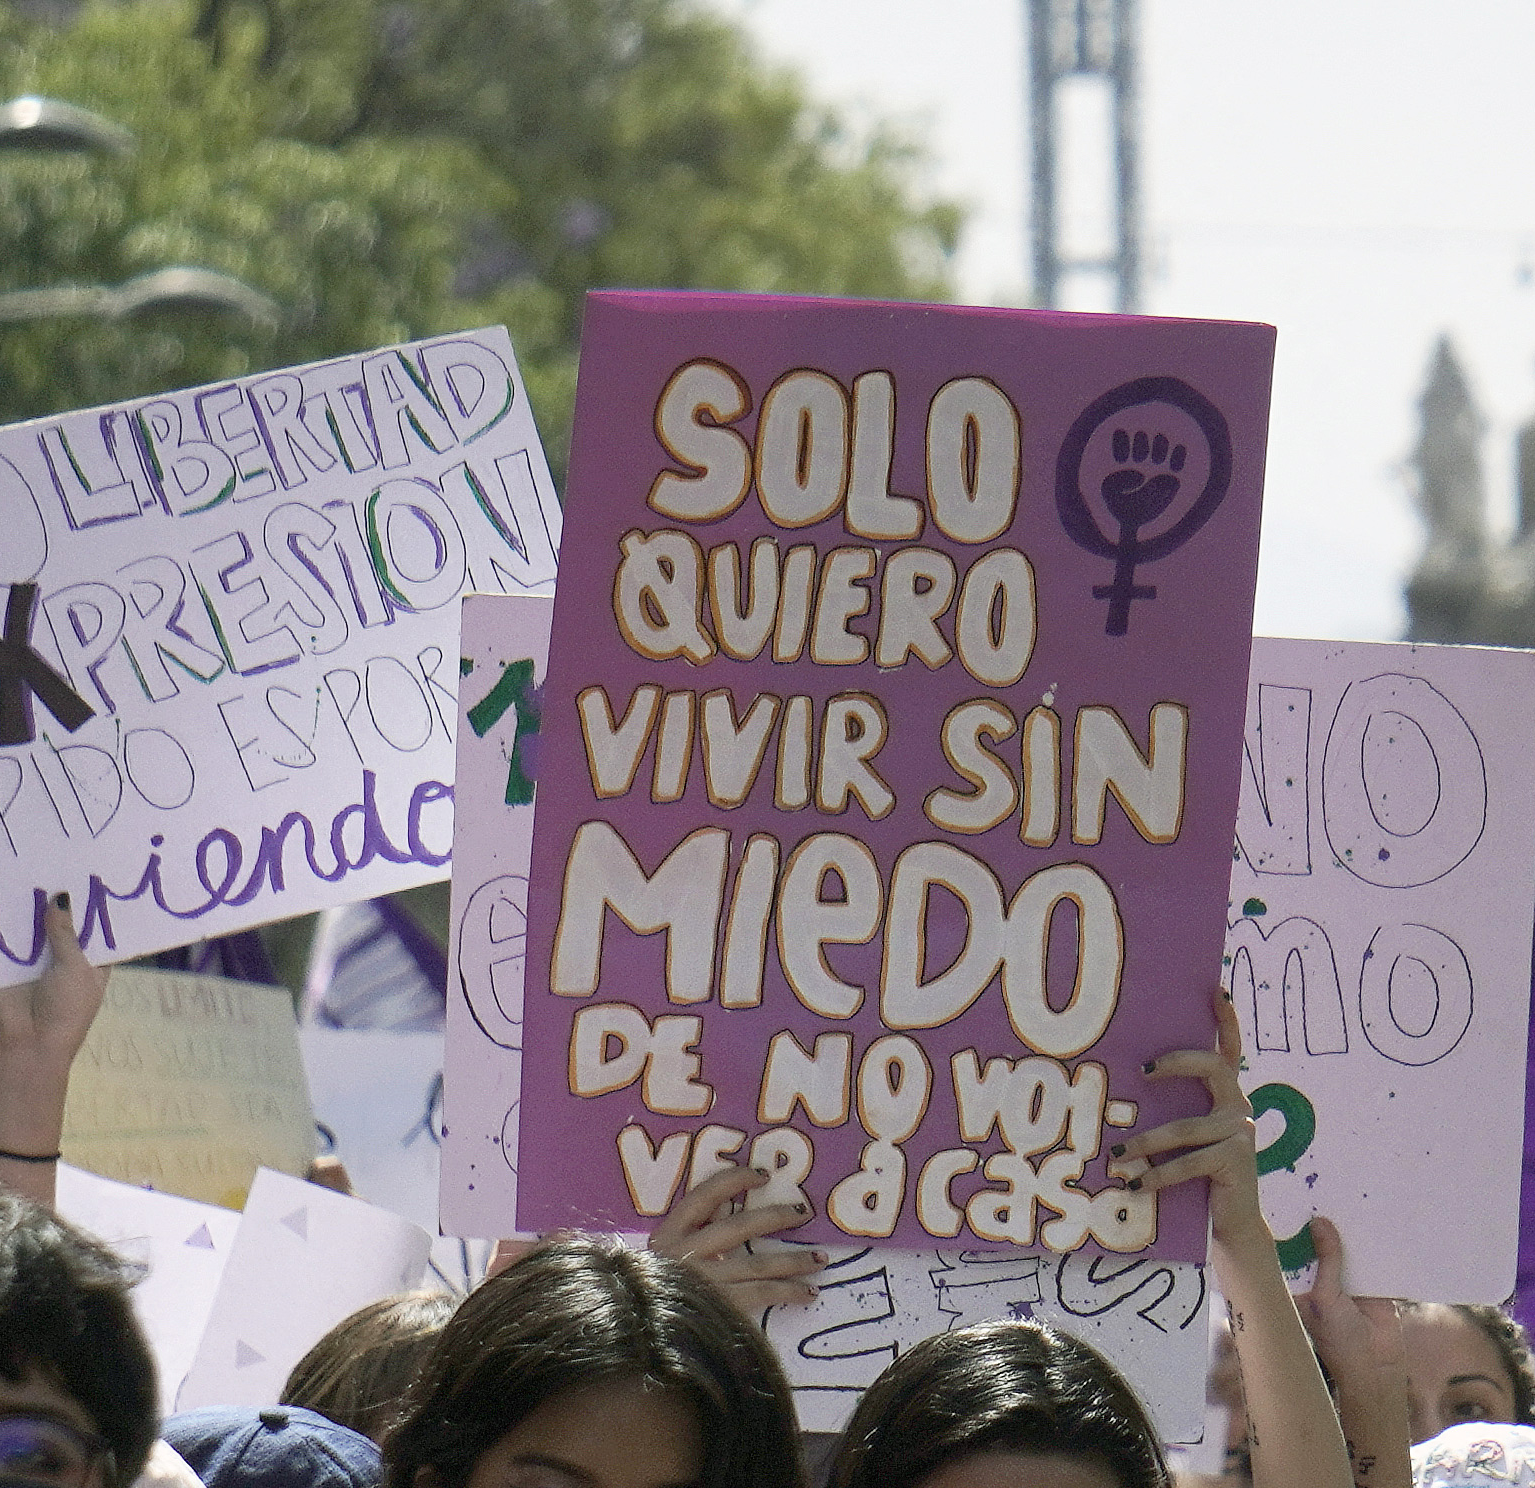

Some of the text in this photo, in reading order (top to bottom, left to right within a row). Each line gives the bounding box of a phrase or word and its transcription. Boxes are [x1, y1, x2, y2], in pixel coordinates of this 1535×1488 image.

[37, 340, 515, 530] LIBERTAD
[649, 356, 1022, 544] SOLO
[613, 528, 1039, 688] QUIERO
[576, 685, 1188, 847] VIVIR SIN
[567, 1003, 715, 1117] DE
[757, 1028, 933, 1148] NO
[826, 1138, 908, 1238] a
